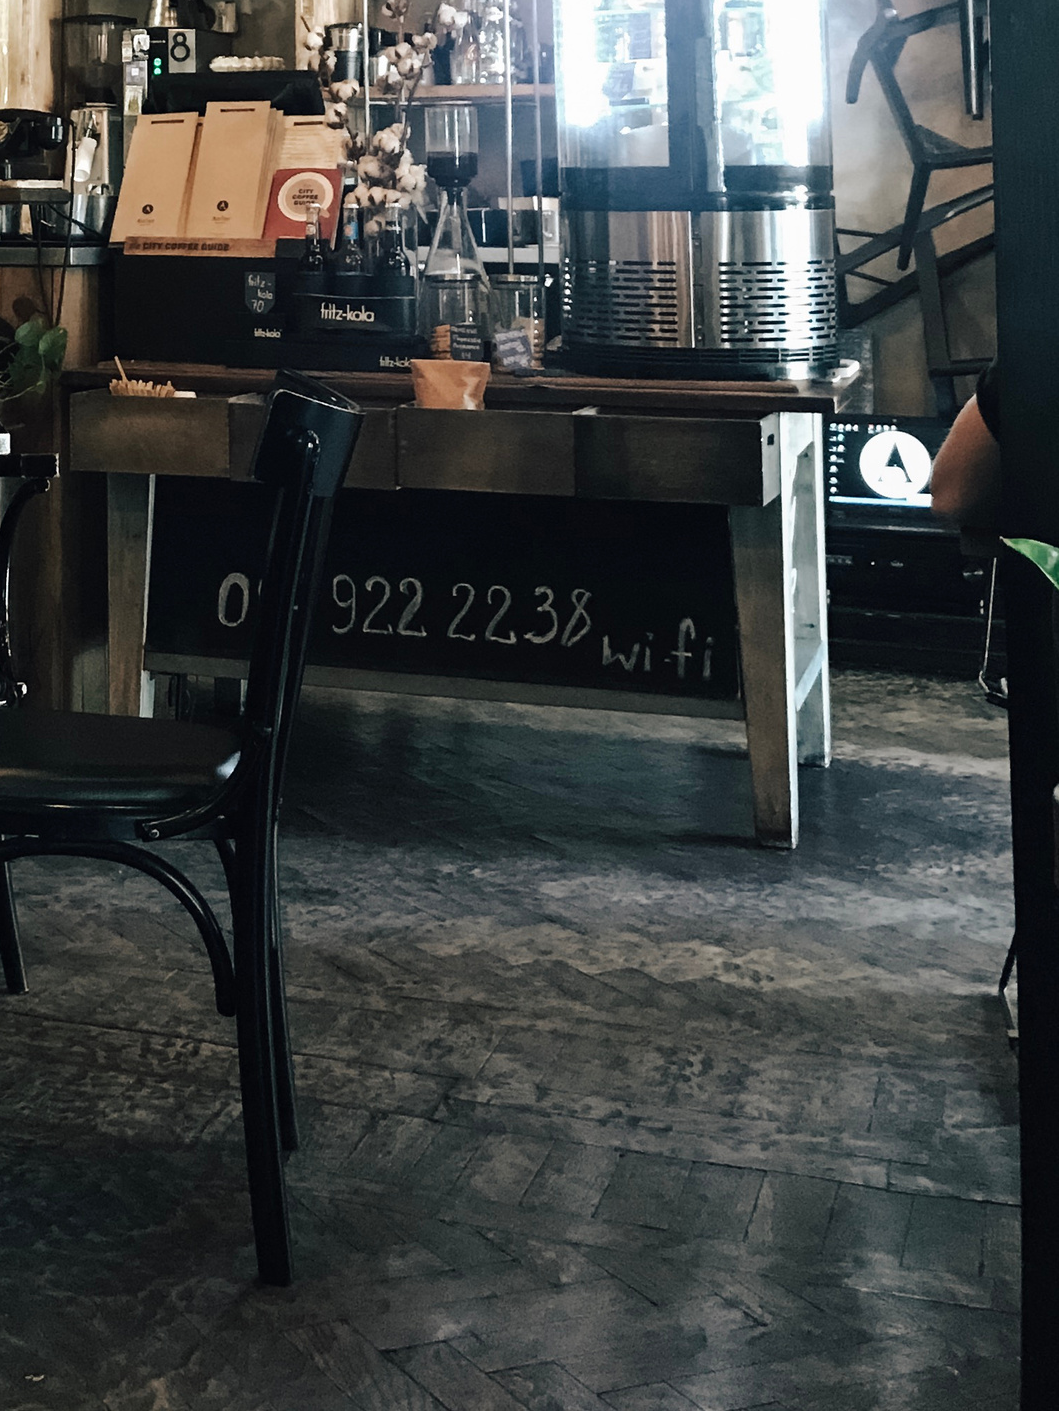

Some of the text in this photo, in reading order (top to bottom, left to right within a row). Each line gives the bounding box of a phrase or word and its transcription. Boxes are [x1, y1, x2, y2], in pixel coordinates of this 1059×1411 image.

[170, 31, 191, 63] 8
[142, 242, 163, 250] CITY
[165, 242, 199, 251] COFFEE
[201, 242, 230, 252] GUIDE
[257, 289, 274, 300] kola
[321, 302, 375, 322] fritz-kola
[332, 573, 427, 634] 922
[602, 617, 715, 681] wi-fi
